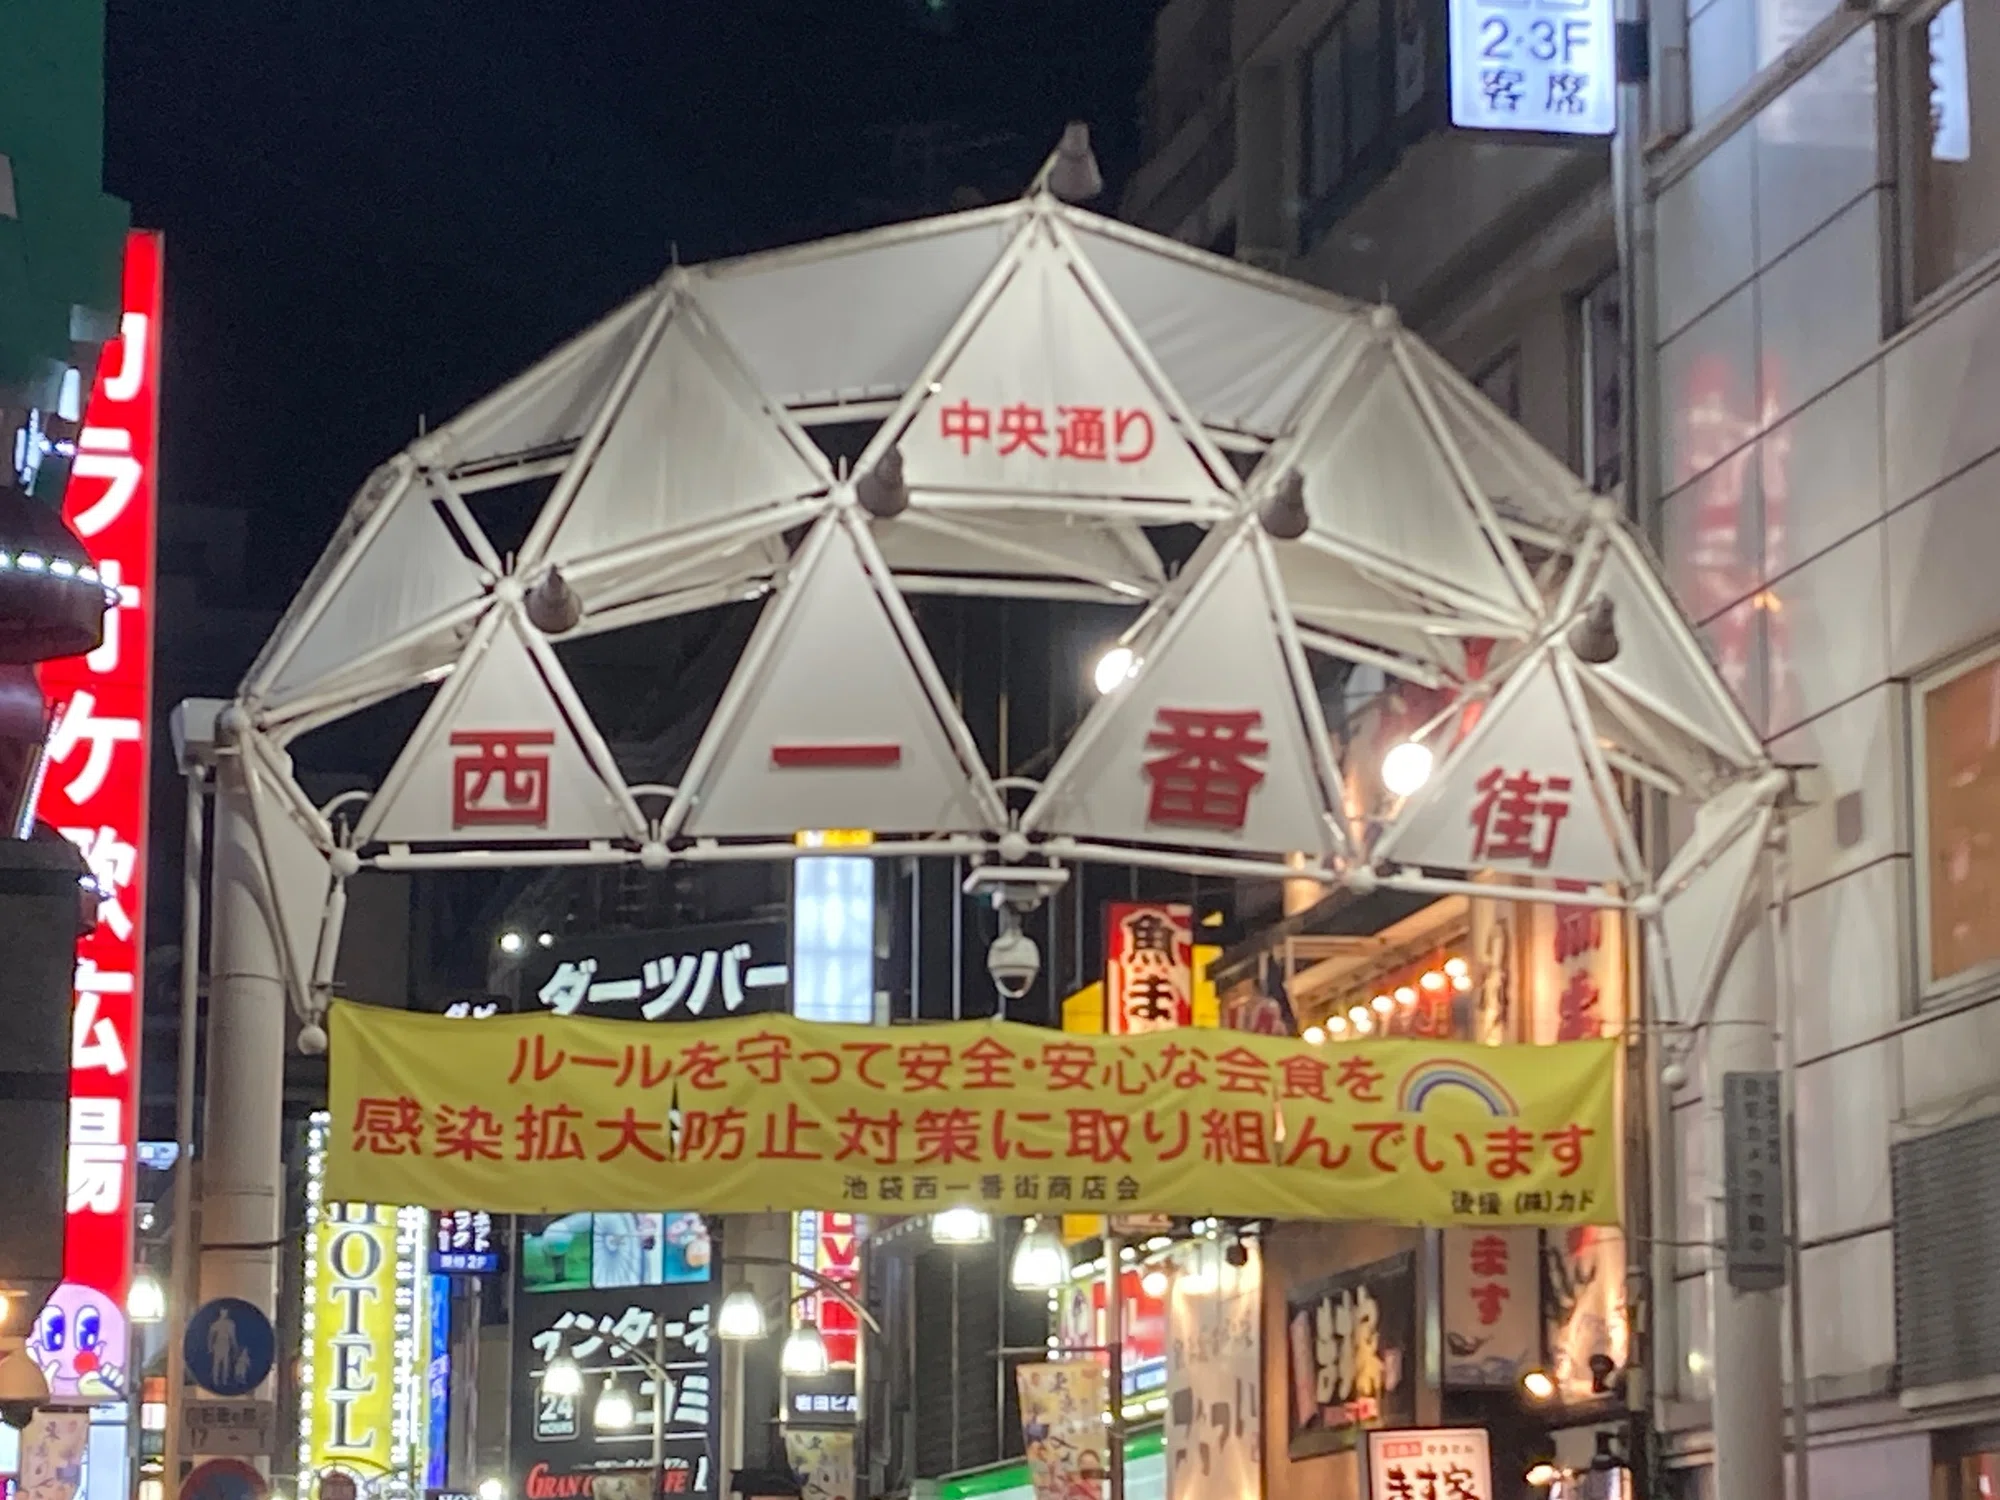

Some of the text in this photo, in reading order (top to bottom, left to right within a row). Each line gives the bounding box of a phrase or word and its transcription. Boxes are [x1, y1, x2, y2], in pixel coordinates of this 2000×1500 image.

[940, 397, 1155, 464] 中央通り
[538, 942, 789, 1021] ダーツバー
[508, 1030, 1385, 1102] ルールを守って安全・安心な会食を
[352, 1095, 1596, 1180] 感染拡大防止対策に取り組んでいます
[843, 1174, 1141, 1202] 池袋西一番街商店会
